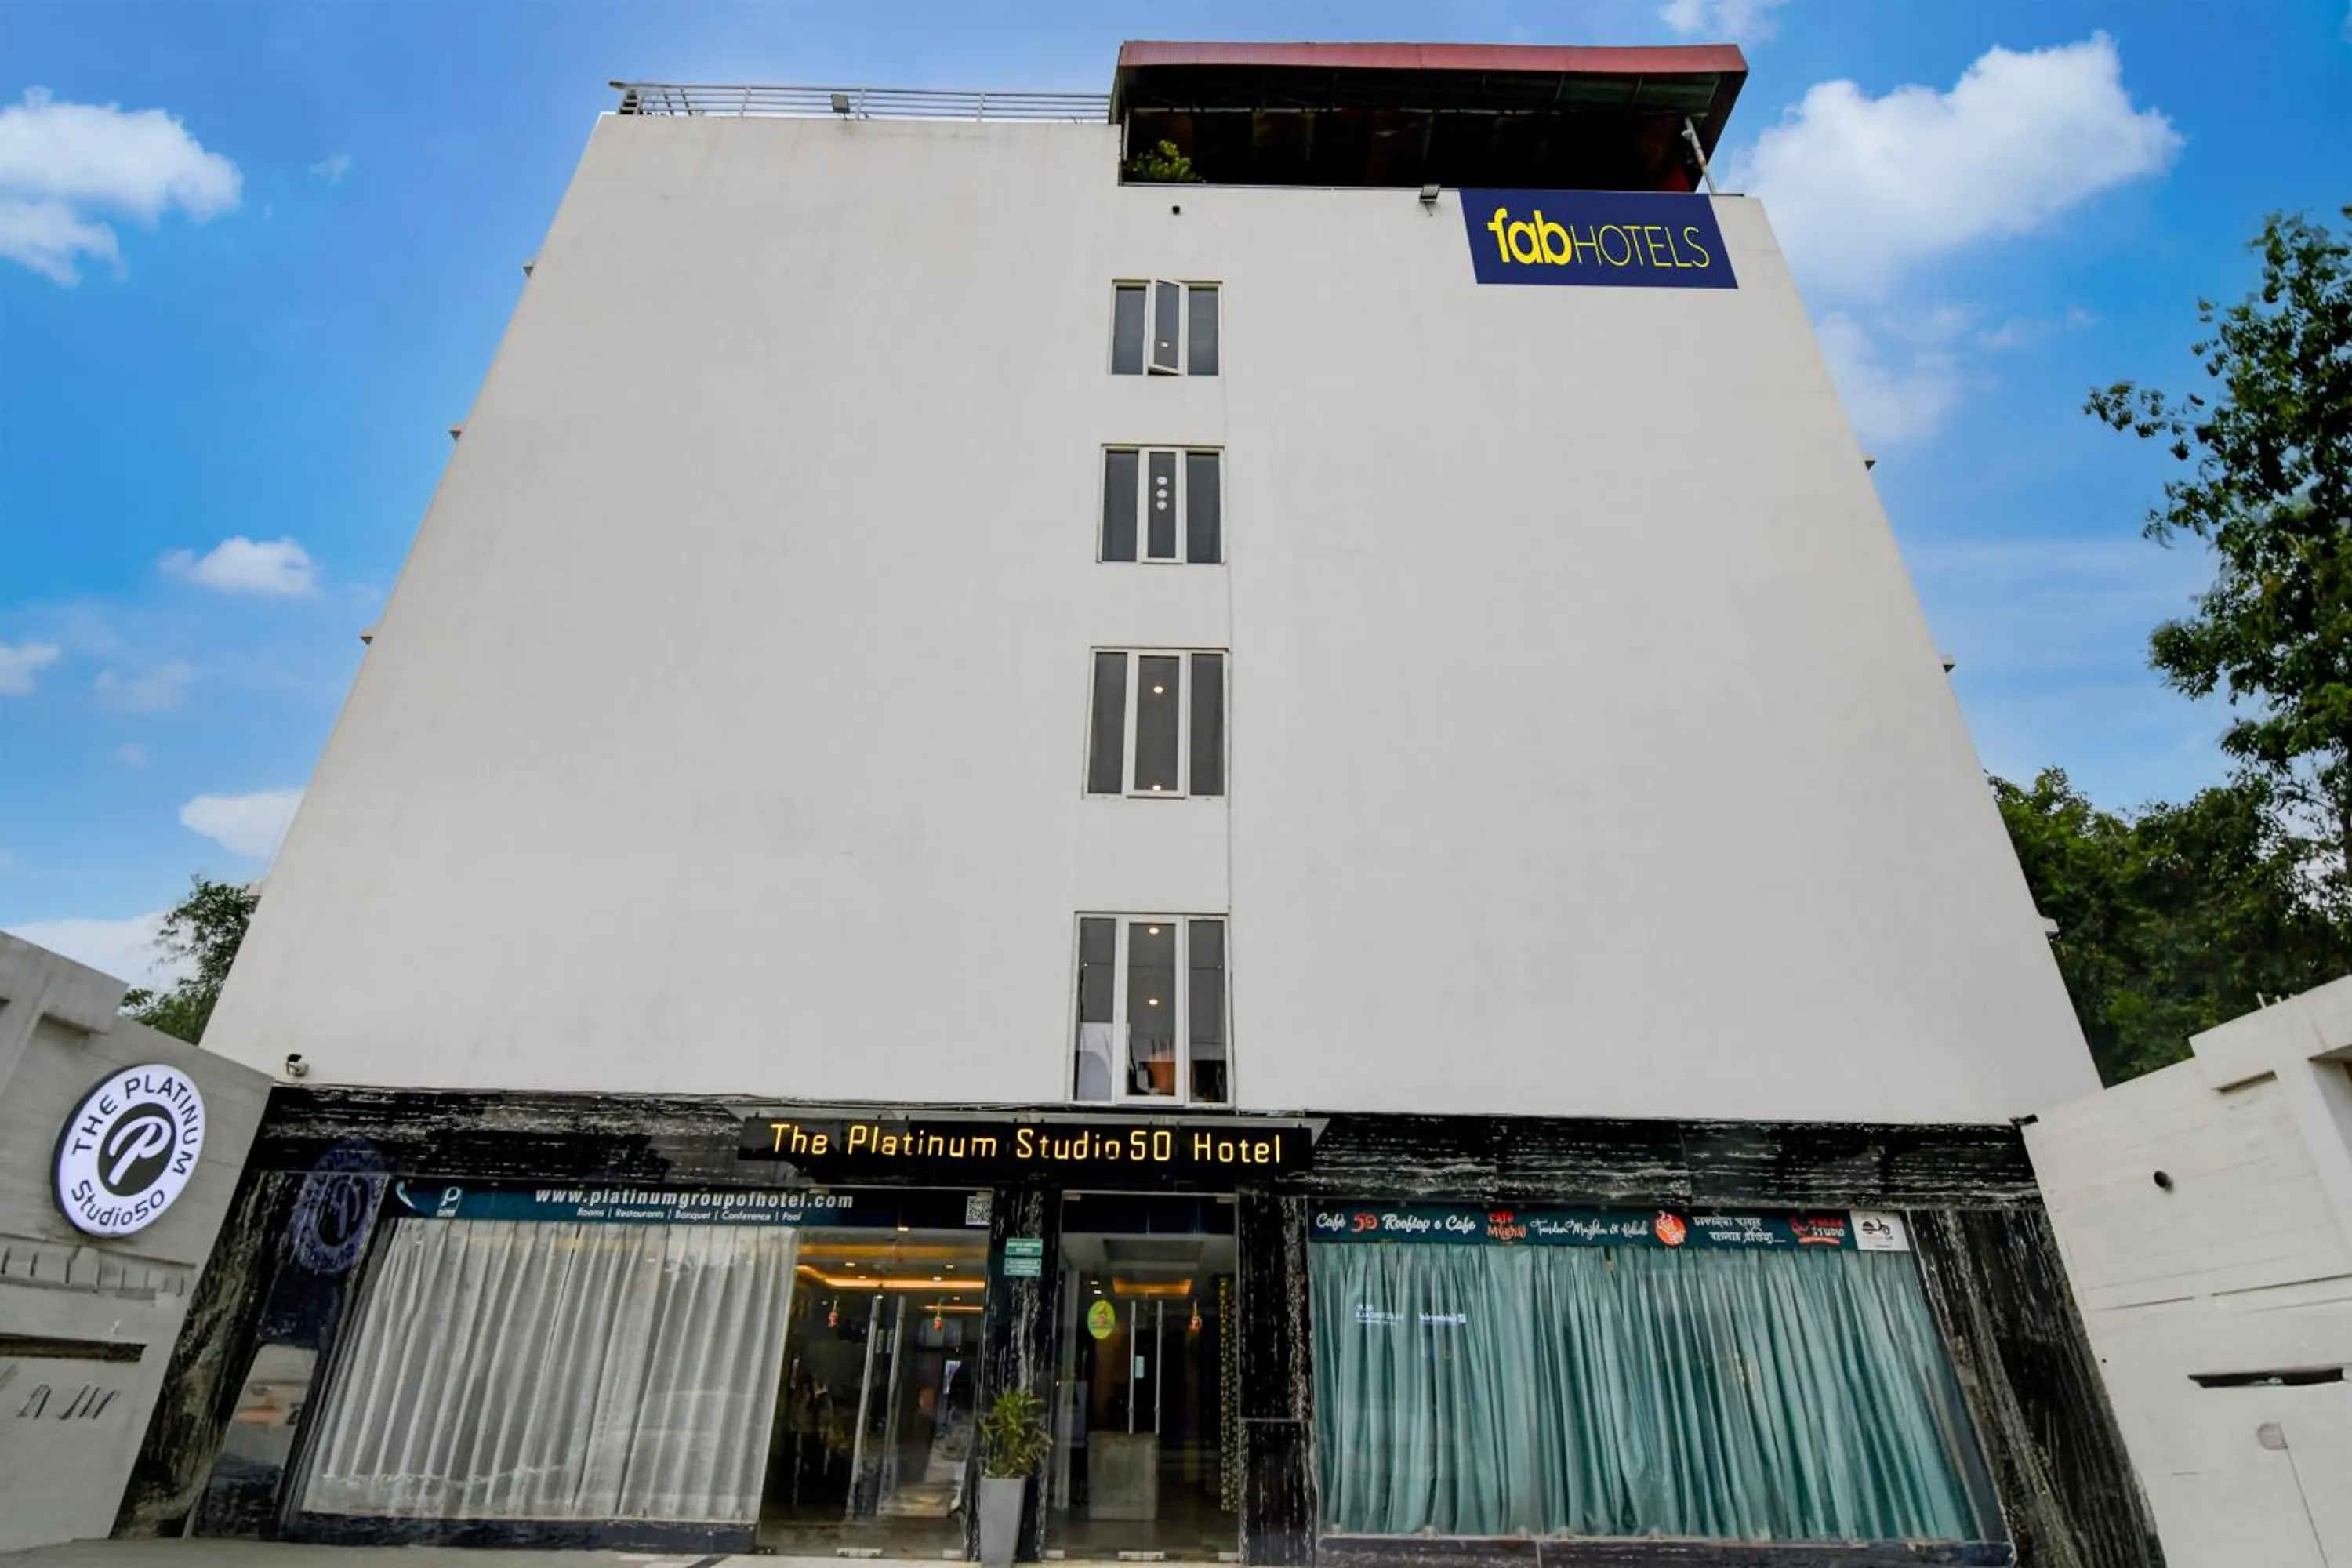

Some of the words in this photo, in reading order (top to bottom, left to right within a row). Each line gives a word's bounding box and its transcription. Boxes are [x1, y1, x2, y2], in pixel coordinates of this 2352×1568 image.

[72, 1094, 118, 1156] THE
[125, 1074, 198, 1175] PLATINUM
[771, 1123, 828, 1154] The
[848, 1125, 996, 1157] Platinum
[1193, 1132, 1281, 1163] Hotel
[71, 1179, 165, 1227] Studio50
[535, 1188, 853, 1209] www.platinumgroupofhotel.com
[577, 1207, 604, 1217] Rooms
[615, 1208, 664, 1218] Restaurants
[674, 1210, 710, 1221] Banquet
[722, 1210, 771, 1221] Conference
[782, 1212, 802, 1221] Pool
[1381, 1213, 1430, 1233] Rooftop
